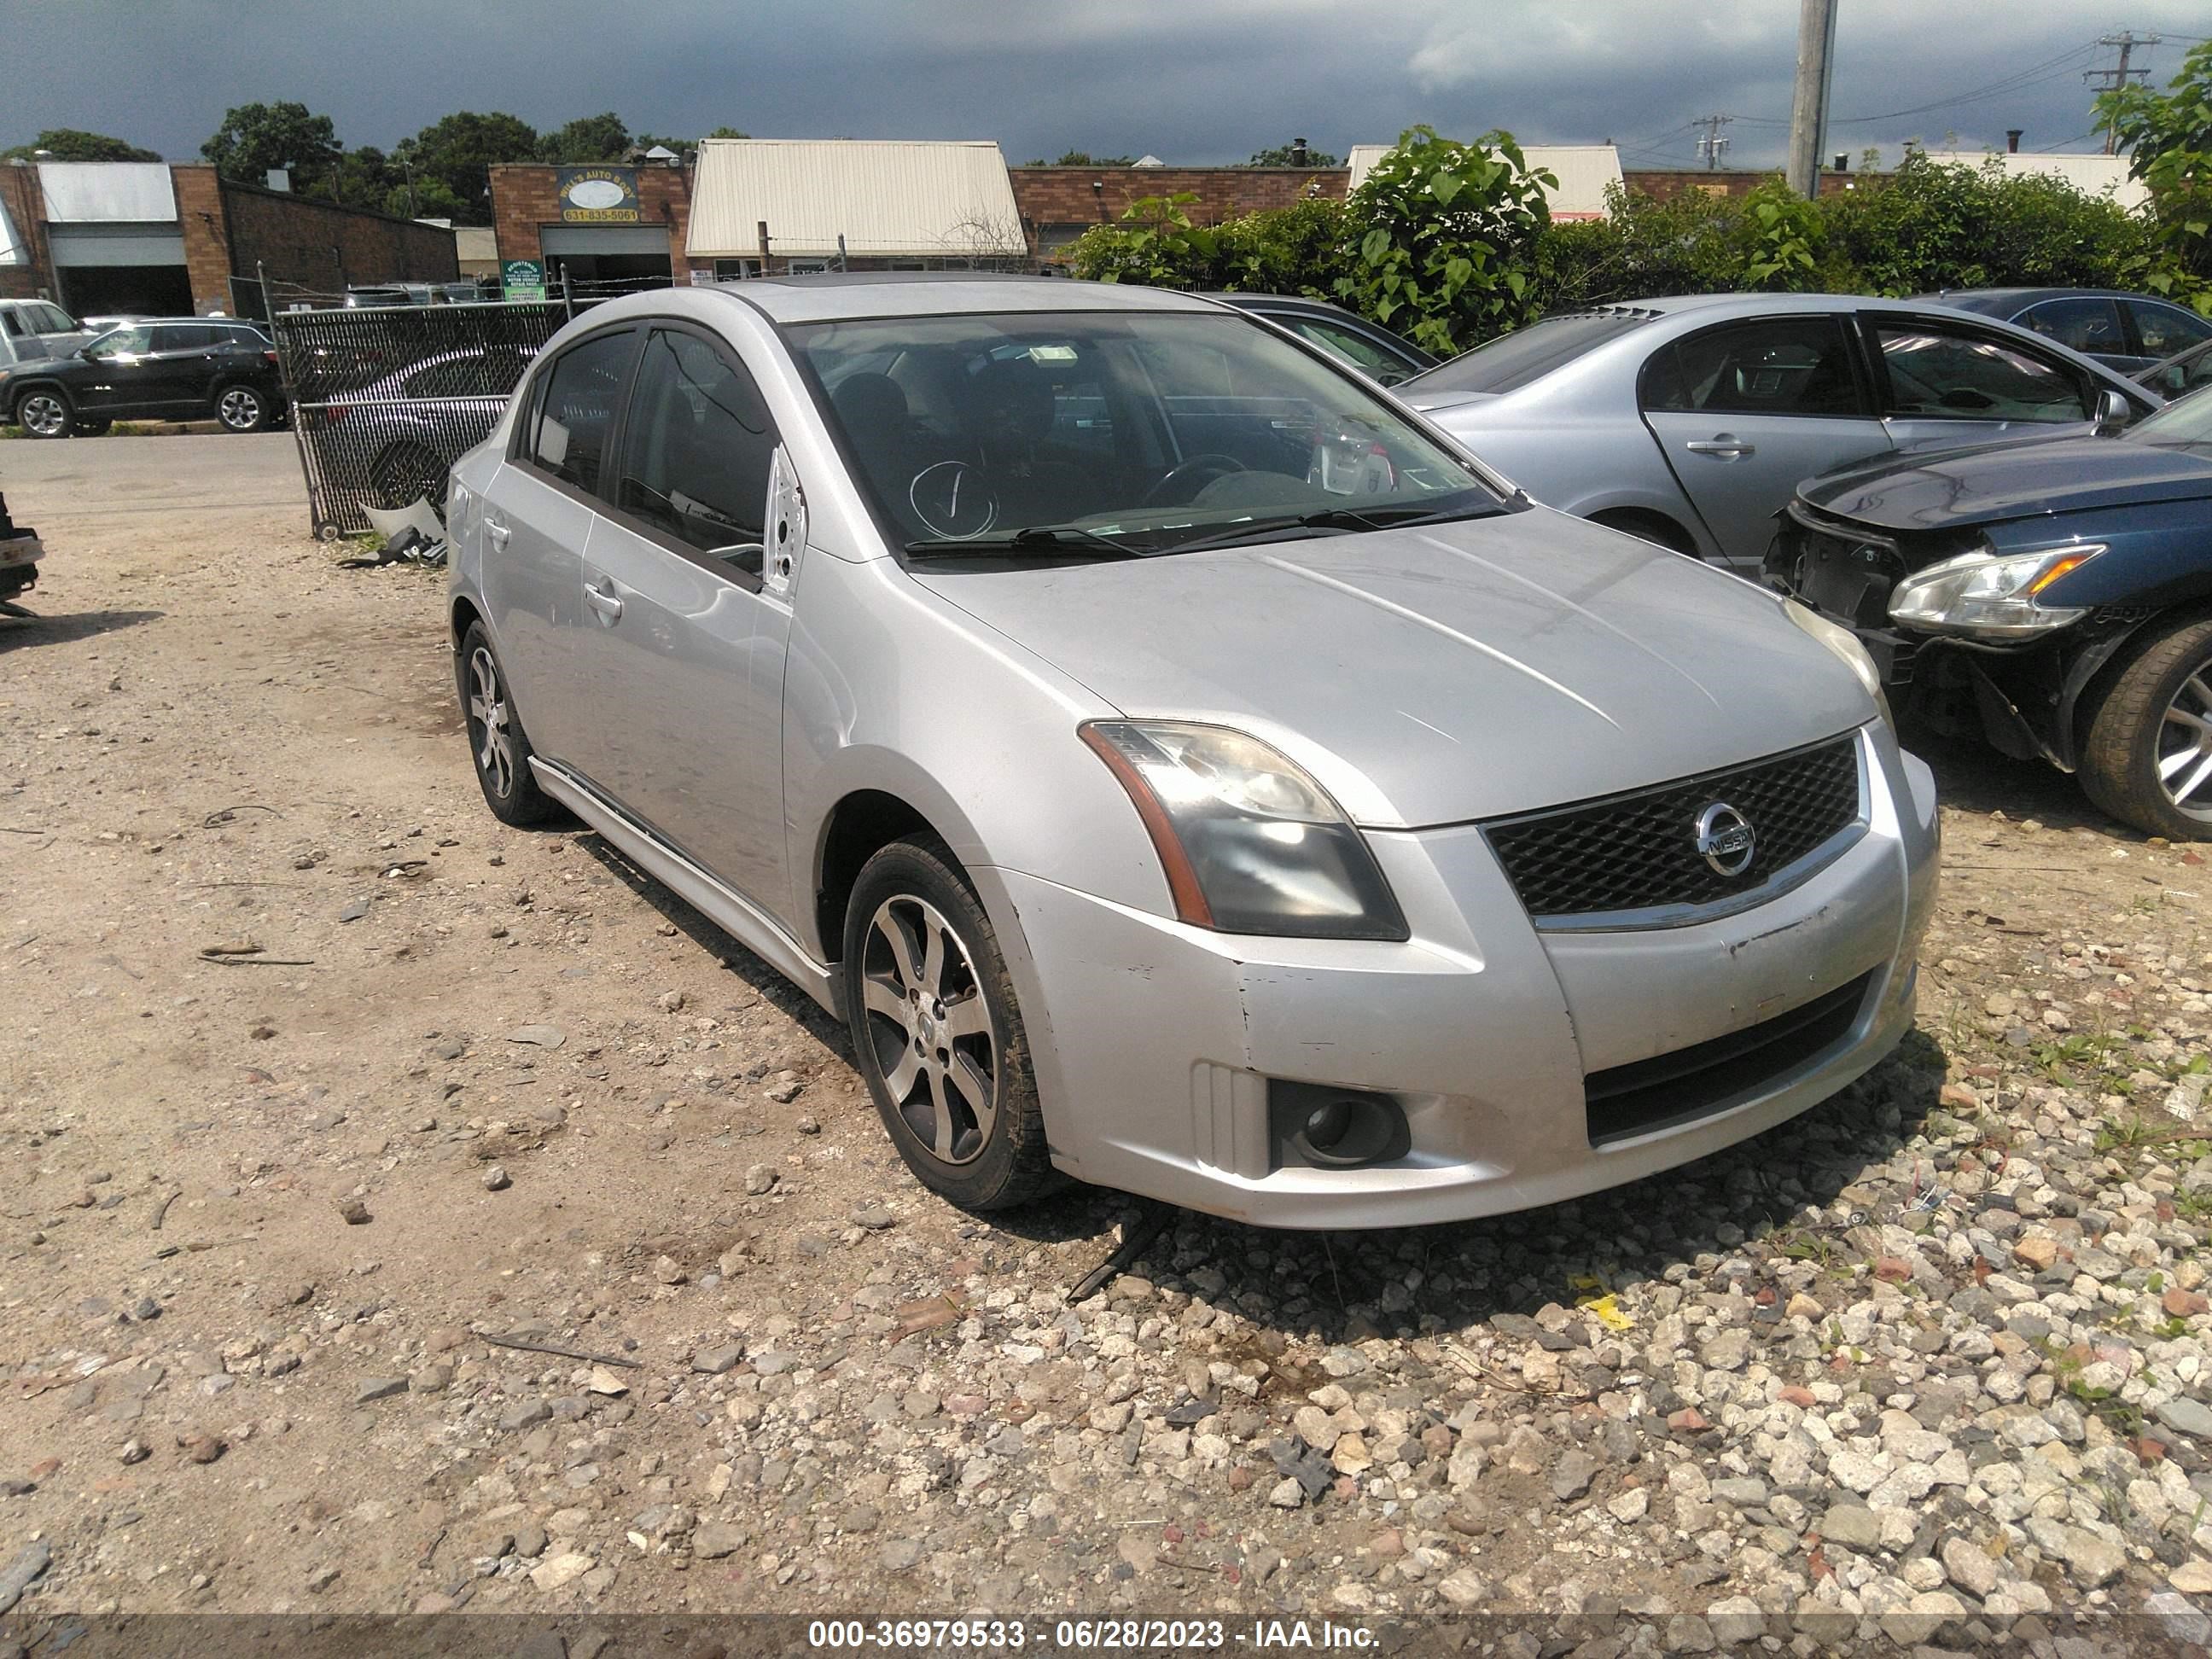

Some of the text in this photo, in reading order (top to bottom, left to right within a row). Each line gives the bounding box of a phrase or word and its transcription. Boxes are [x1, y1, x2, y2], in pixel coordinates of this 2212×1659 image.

[560, 170, 636, 199] WILL'S AUTO BODY
[565, 211, 636, 220] 631-835-5061
